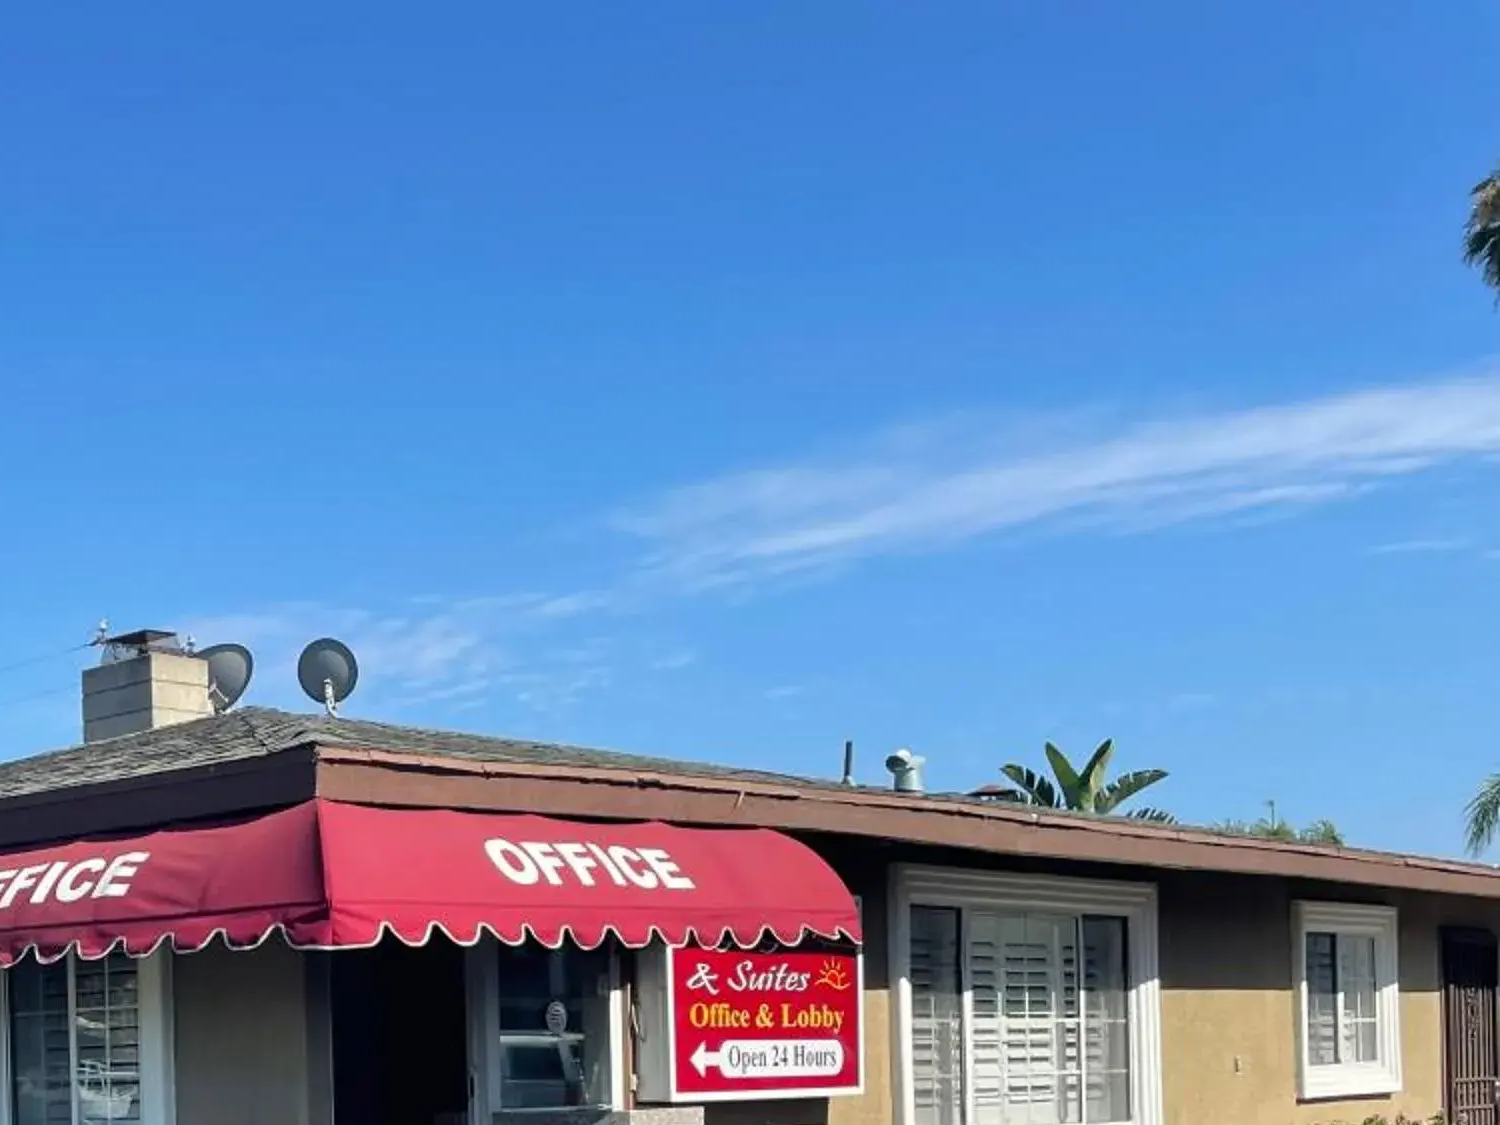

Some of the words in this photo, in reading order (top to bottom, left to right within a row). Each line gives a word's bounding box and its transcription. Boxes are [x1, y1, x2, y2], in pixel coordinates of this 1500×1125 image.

[484, 837, 696, 889] OFFICE
[685, 963, 720, 995] &
[727, 960, 811, 992] Suites
[689, 1002, 750, 1028] Office
[755, 1003, 775, 1028] &
[781, 1003, 845, 1035] Lobby
[729, 1045, 767, 1074] Open
[772, 1045, 789, 1067] 24
[793, 1044, 837, 1067] Hours
